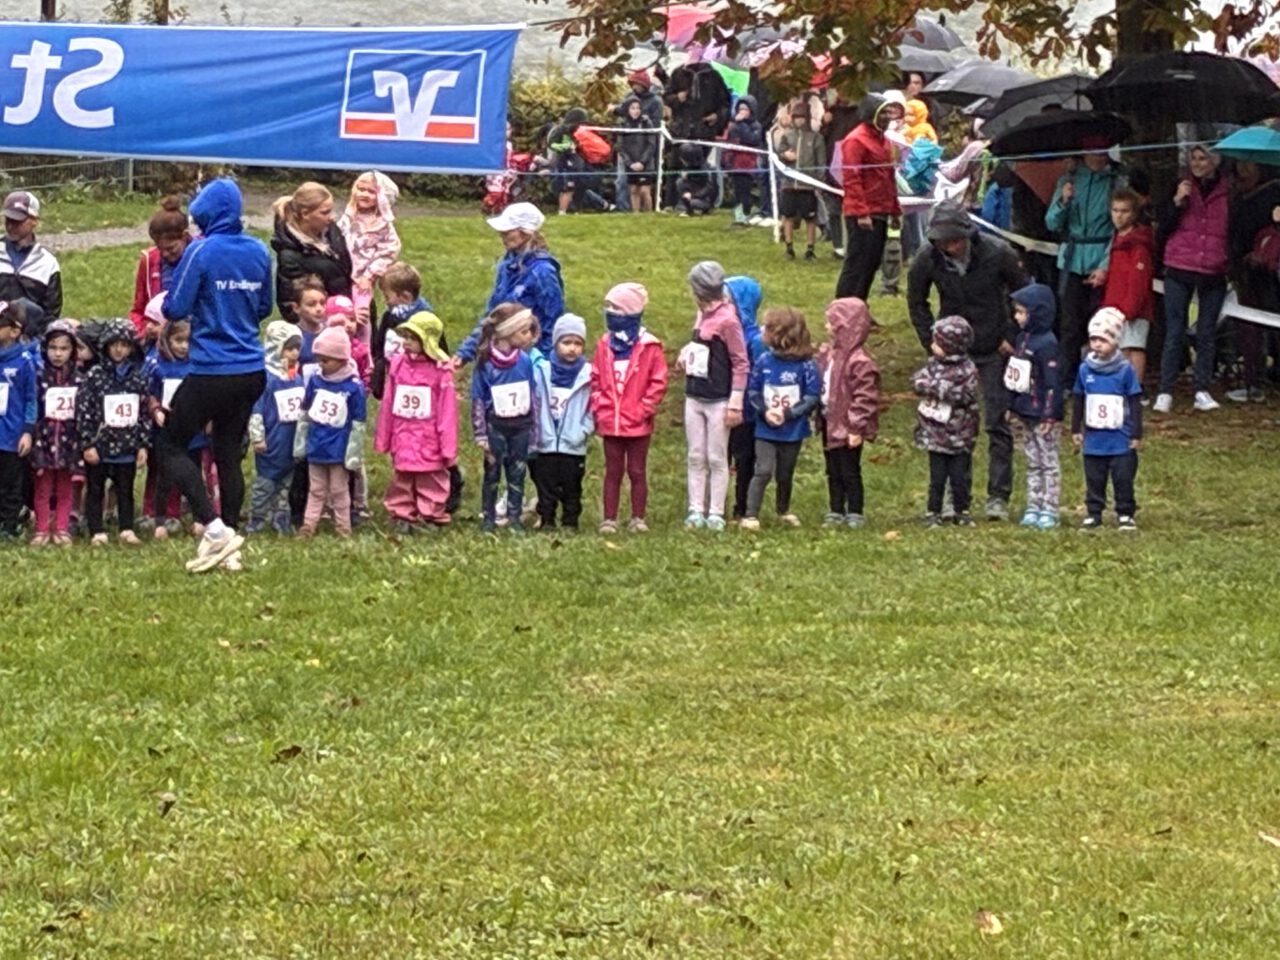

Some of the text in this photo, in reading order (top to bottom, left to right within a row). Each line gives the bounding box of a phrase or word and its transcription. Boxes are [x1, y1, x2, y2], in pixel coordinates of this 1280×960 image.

[215, 280, 227, 290] TV
[1007, 365, 1021, 382] 30
[56, 396, 75, 411] 21
[401, 394, 421, 410] 39
[508, 392, 517, 407] 7
[771, 394, 791, 409] 56
[116, 403, 132, 418] 43
[319, 400, 339, 418] 53
[1097, 404, 1107, 418] 8
